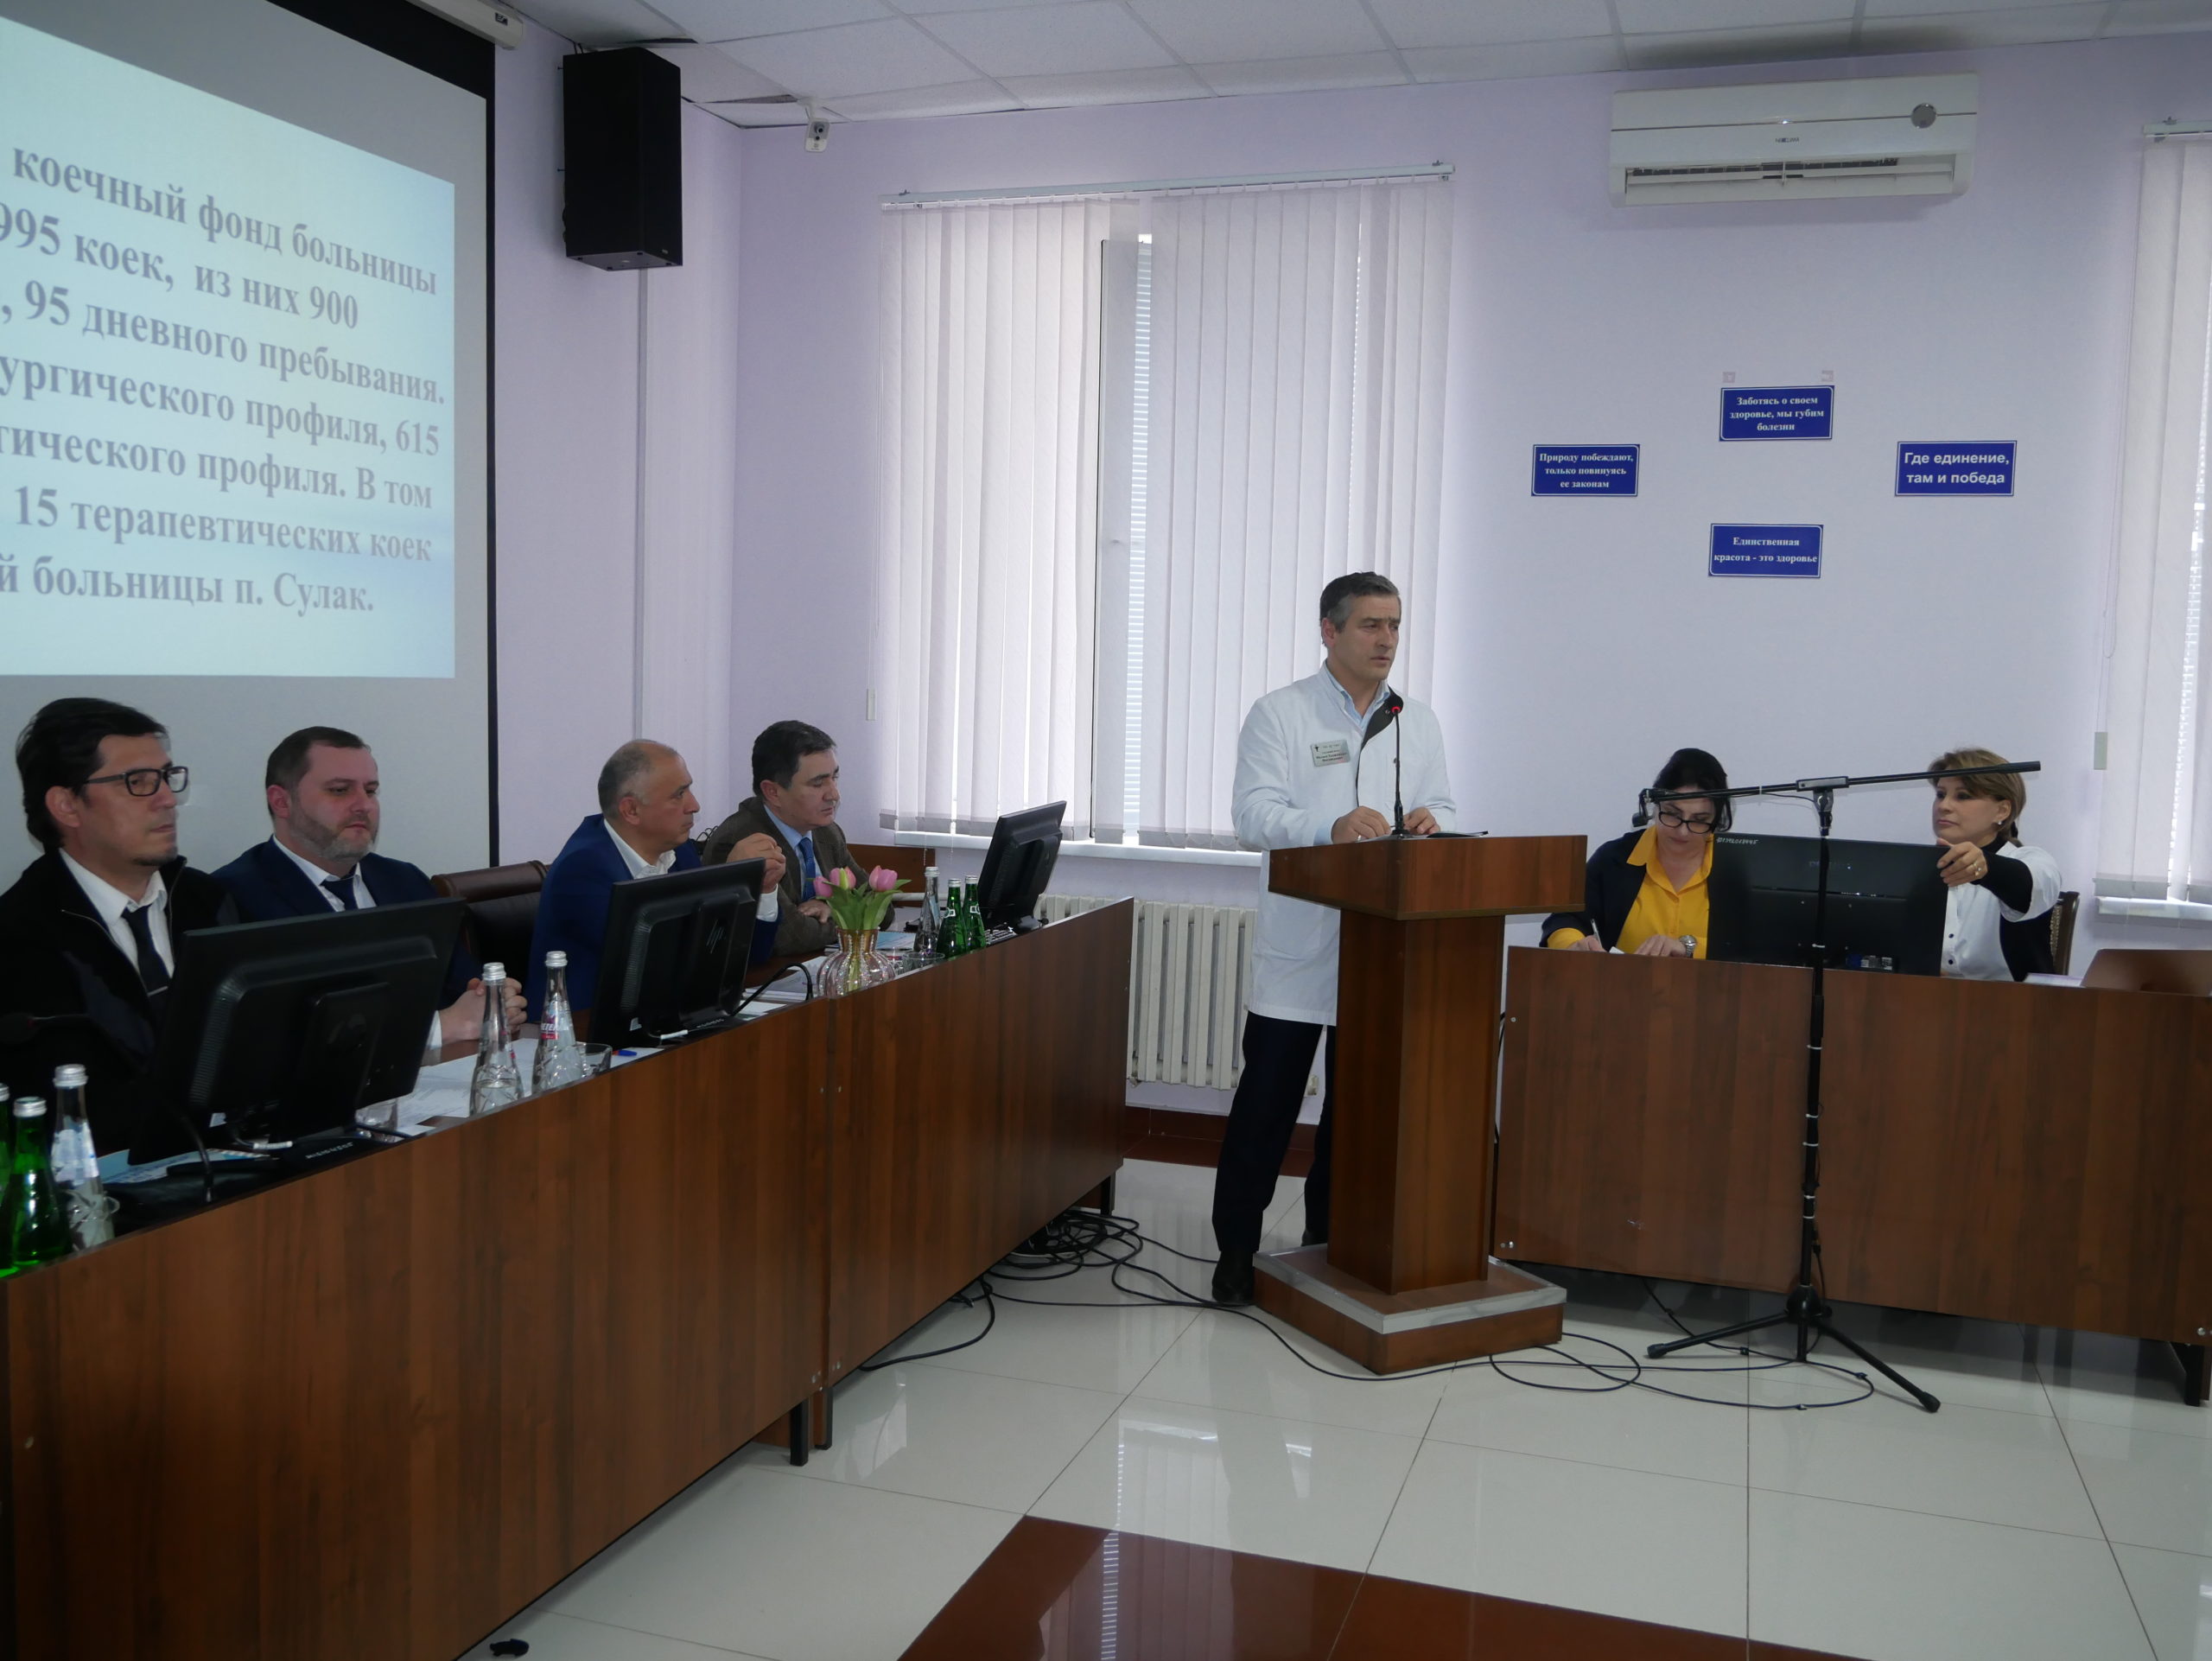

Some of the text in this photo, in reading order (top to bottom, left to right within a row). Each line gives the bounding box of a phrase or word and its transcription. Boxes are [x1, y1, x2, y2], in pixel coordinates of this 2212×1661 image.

[13, 147, 437, 296] коечный фонд больницы
[75, 234, 174, 292] коек,
[194, 264, 232, 298] из
[243, 277, 301, 315] них
[309, 285, 359, 329] 900
[24, 280, 445, 404] 95 дневного пребывания.
[1736, 396, 1779, 405] Заботясь
[1730, 410, 1775, 420] здоровье,
[1795, 409, 1824, 419] губим
[245, 399, 387, 454] профиля,
[395, 419, 439, 456] 615
[1757, 422, 1796, 431] болезни
[1539, 453, 1634, 463] Природу побеждают,
[1904, 452, 2010, 466] Где единение,
[1578, 468, 1627, 476] повинуясь
[1906, 472, 2005, 485] там и победа
[198, 453, 346, 498] профиля.
[355, 467, 376, 500] В
[385, 480, 433, 509] том
[14, 485, 432, 562] 15 терапевтических коек
[1732, 537, 1800, 546] Единственная
[1713, 555, 1751, 563] красота
[1776, 555, 1818, 564] здоровье
[33, 556, 223, 607] больницы
[234, 578, 264, 606] п.
[273, 572, 374, 618] Сулак.
